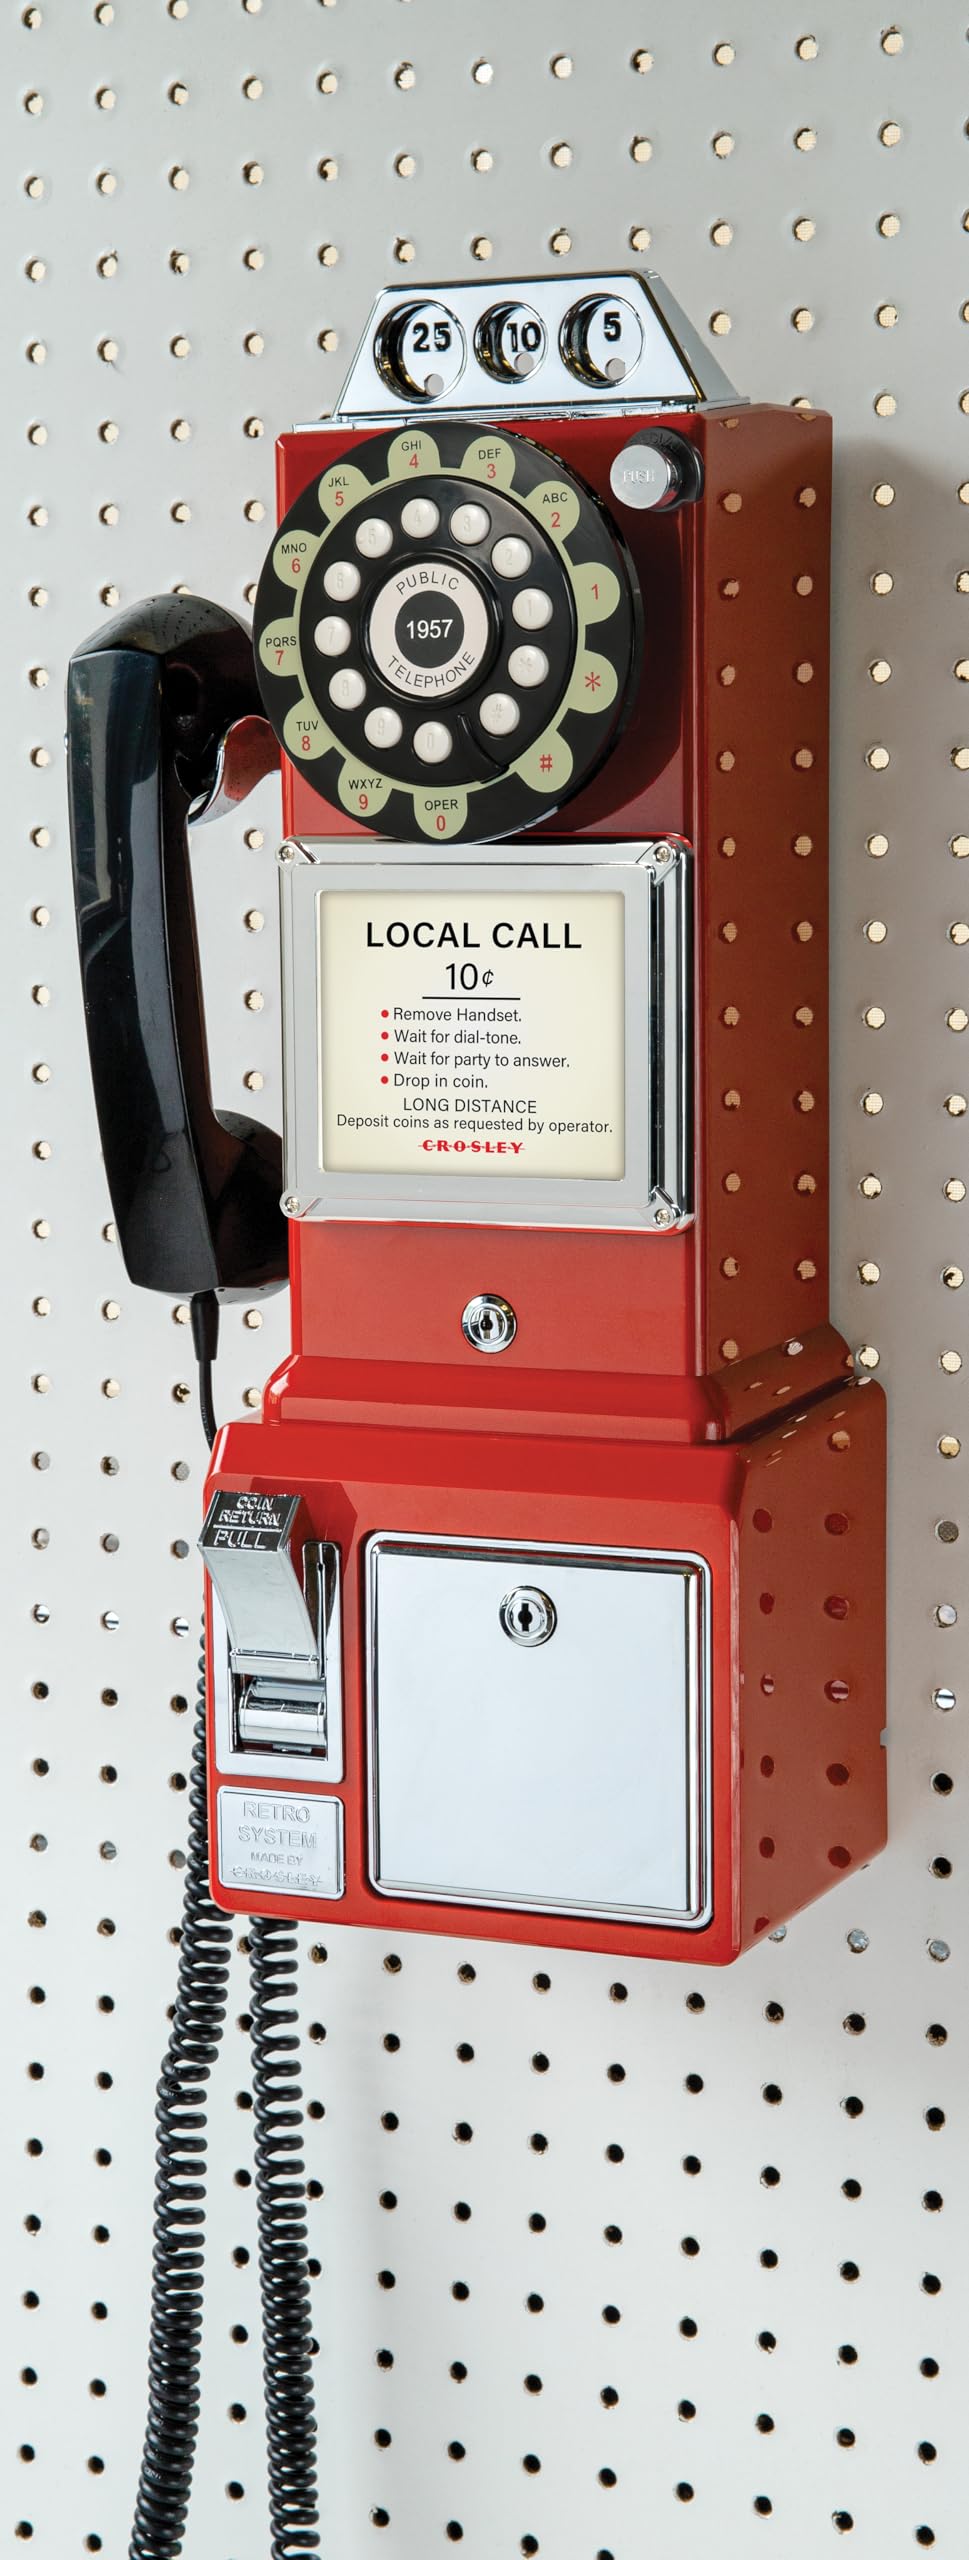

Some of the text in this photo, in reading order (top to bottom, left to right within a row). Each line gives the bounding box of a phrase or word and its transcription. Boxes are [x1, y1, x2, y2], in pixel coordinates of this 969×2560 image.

[604, 311, 622, 342] 5
[413, 321, 451, 352] 25
[506, 321, 541, 352] 10
[401, 440, 422, 452] GHI
[478, 447, 501, 460] DEF
[409, 453, 419, 468] 4
[487, 463, 497, 480] 3
[623, 469, 656, 484] PUSH
[328, 476, 350, 488] JKL
[335, 491, 344, 507] 5
[542, 491, 568, 504] ABC
[551, 511, 561, 529] 2
[281, 542, 307, 555] MNO
[291, 559, 301, 573] 6
[396, 571, 459, 595] PUBLIC
[592, 583, 599, 599] 1
[406, 618, 454, 639] 1957
[265, 635, 297, 648] PQRS
[275, 649, 285, 665] 7
[387, 651, 475, 688] TELEPHONE
[295, 719, 319, 732] TUV
[301, 735, 311, 752] 8
[539, 754, 553, 772] #
[348, 778, 383, 790] WXYZ
[358, 794, 369, 810] 9
[424, 799, 459, 811] OPER
[435, 815, 447, 833] 0
[367, 921, 582, 949] LOCAL CALL
[445, 962, 494, 991] 10¢
[393, 1007, 522, 1022] Remove Handset.
[394, 1028, 521, 1045] Wait for dial-tone.
[393, 1050, 570, 1070] Wait for party to answer.
[394, 1073, 488, 1091] Drop in coin.
[403, 1097, 537, 1114] LONG DISTANCE
[337, 1113, 613, 1135] Deposit coins as requested by operator.
[421, 1139, 522, 1154] CROSLEY
[236, 1496, 274, 1511] COIN
[218, 1509, 281, 1526] RETURN
[213, 1529, 267, 1549] PULL
[243, 1800, 311, 1823] RETRO
[238, 1825, 317, 1848] SYSTEM
[250, 1851, 304, 1866] MADE BY
